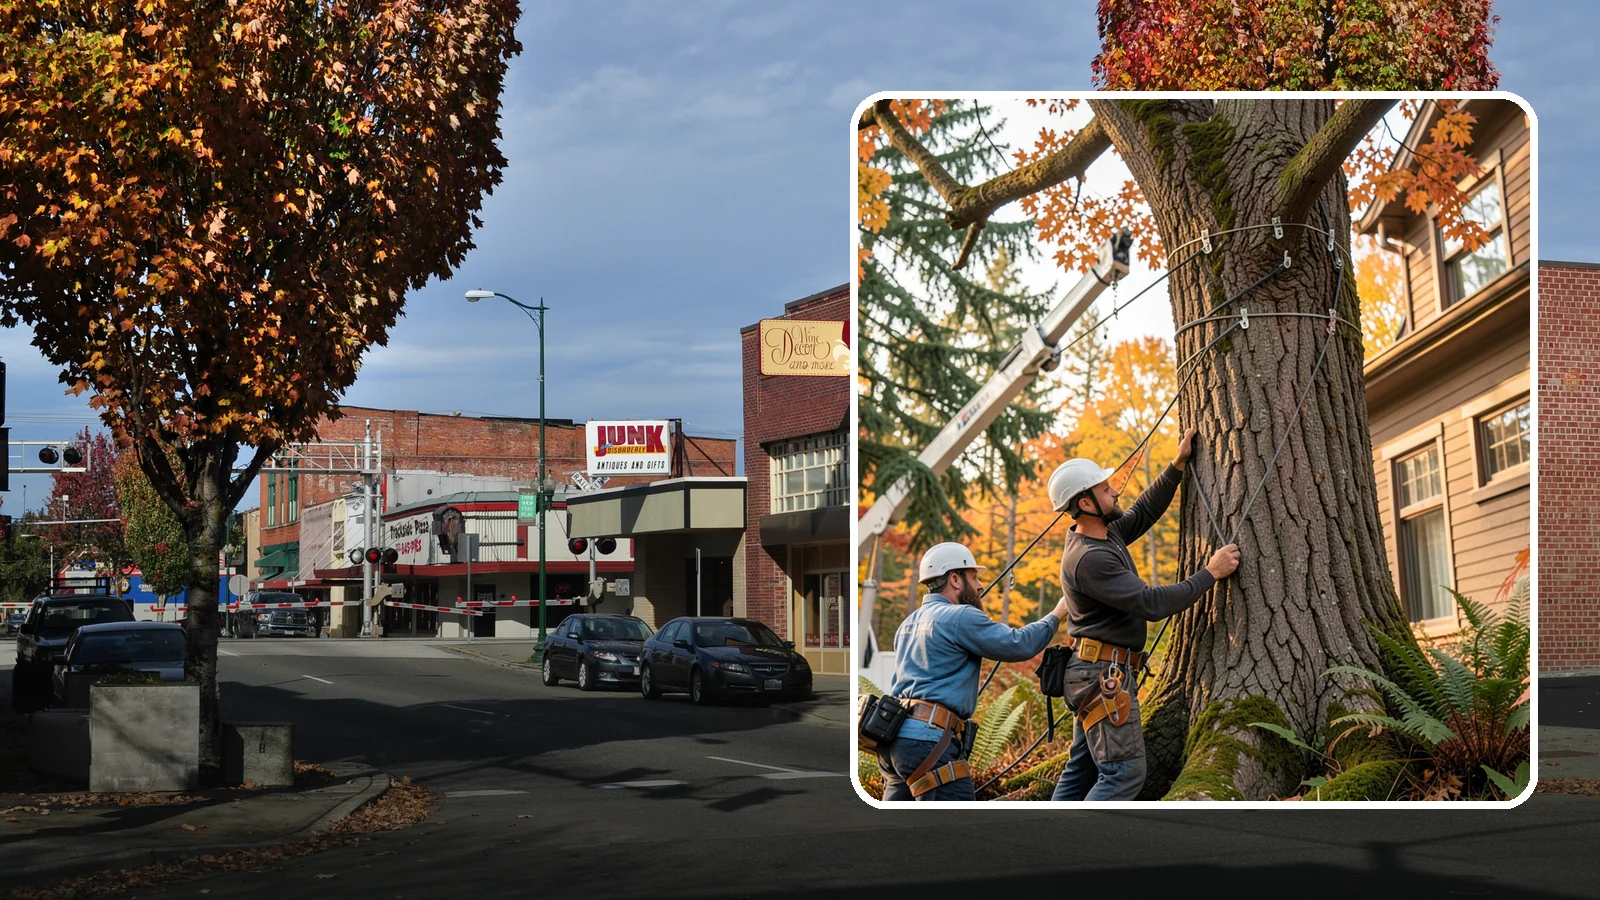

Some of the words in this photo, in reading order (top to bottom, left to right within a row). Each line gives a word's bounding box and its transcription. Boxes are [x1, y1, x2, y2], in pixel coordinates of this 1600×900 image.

[765, 328, 830, 365] Decor
[596, 425, 665, 457] JUNK
[607, 446, 646, 454] DISORDERLY
[597, 461, 628, 470] ANTIQUES
[631, 461, 644, 469] AND
[647, 460, 666, 469] GIFTS
[415, 519, 429, 534] Pizza
